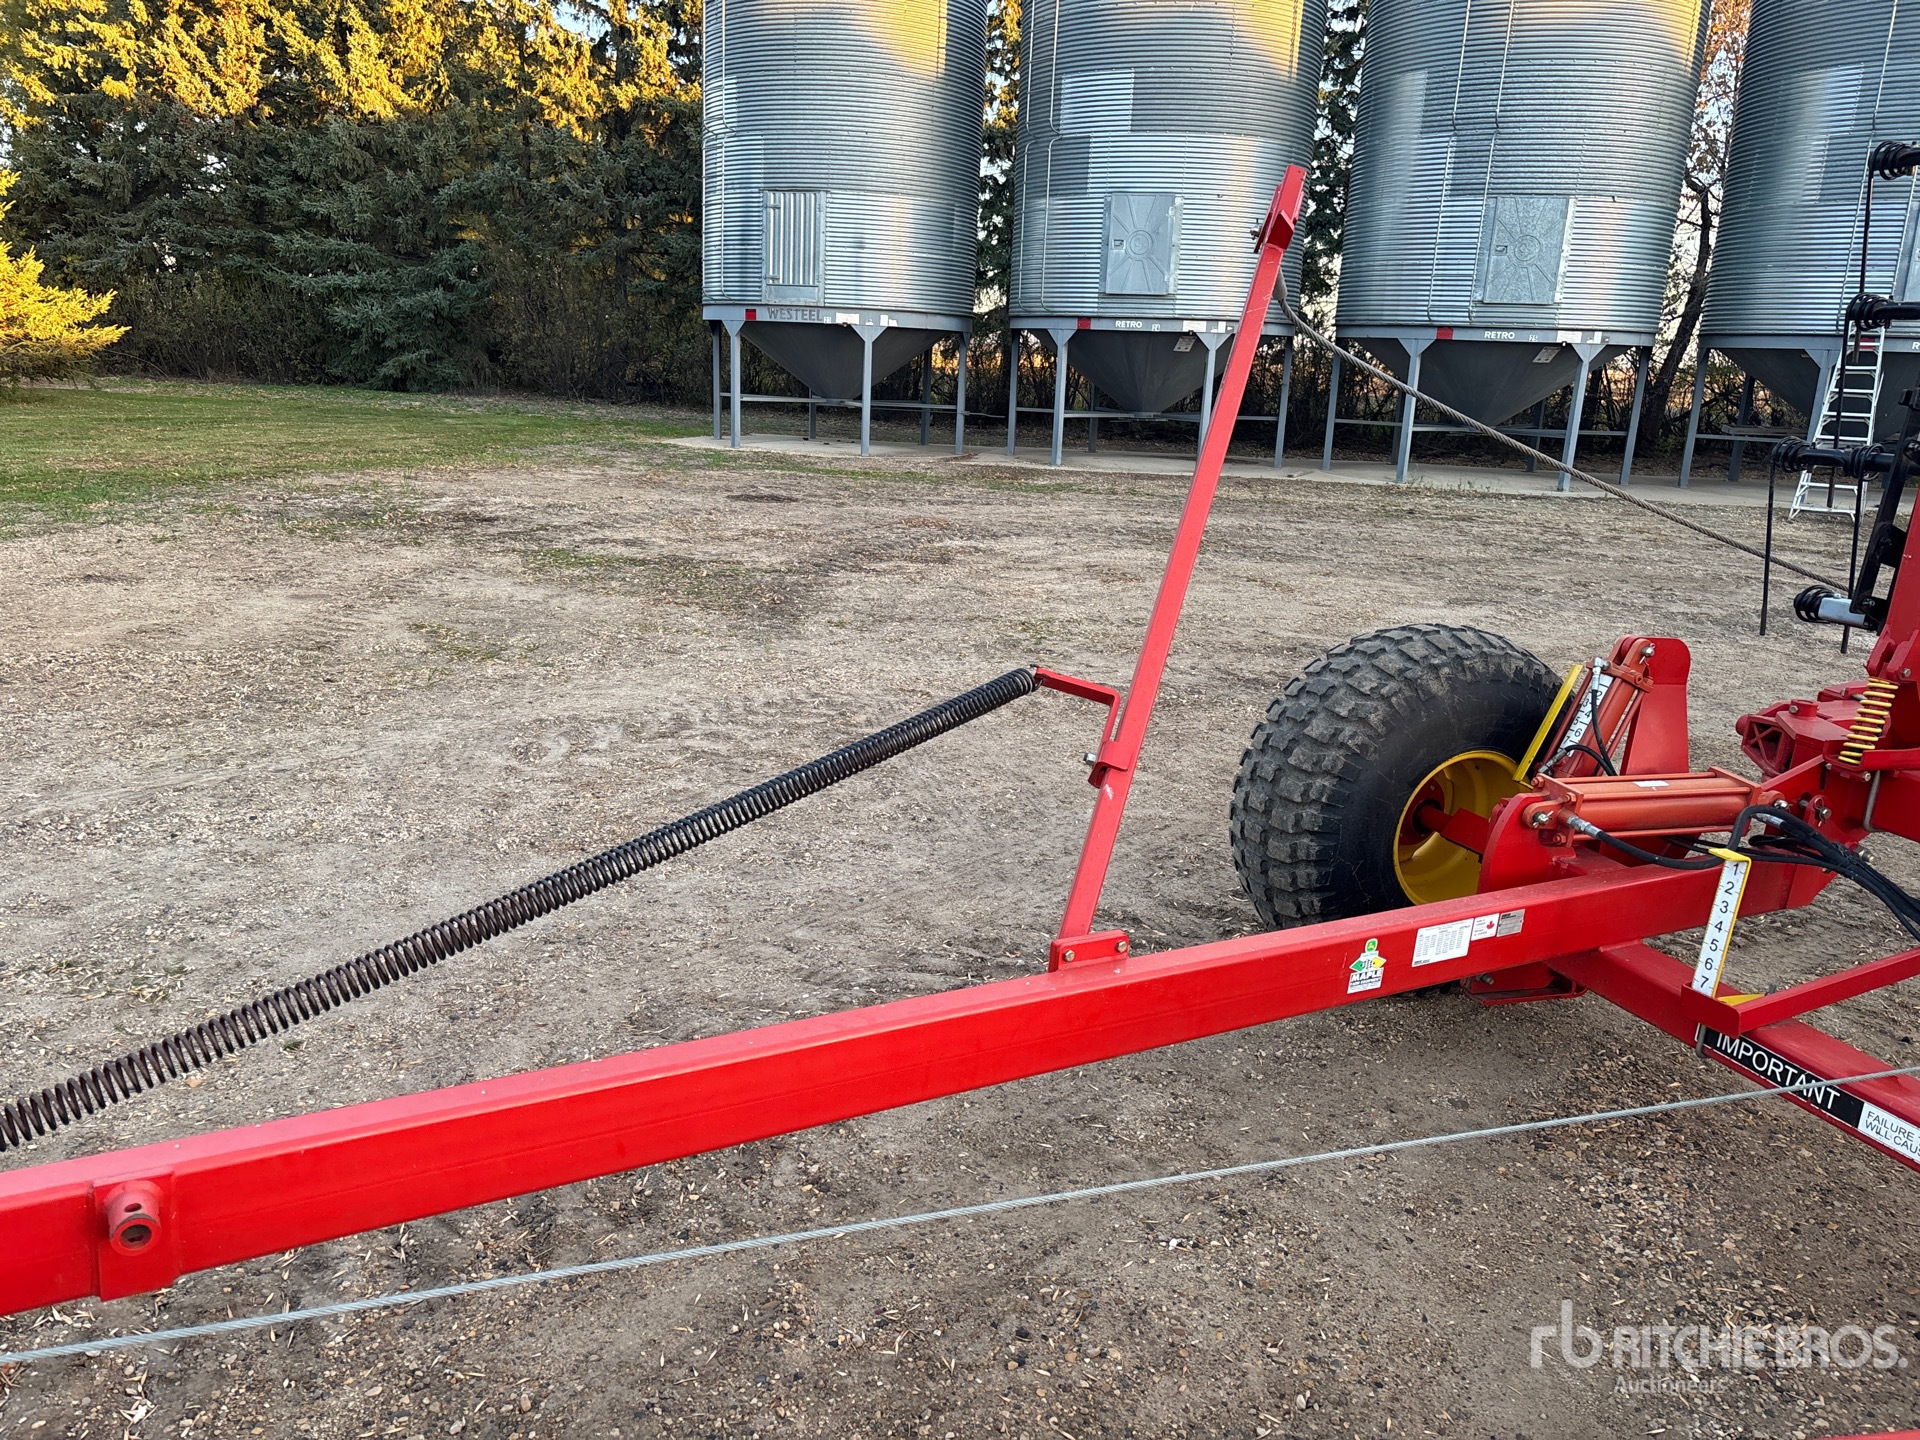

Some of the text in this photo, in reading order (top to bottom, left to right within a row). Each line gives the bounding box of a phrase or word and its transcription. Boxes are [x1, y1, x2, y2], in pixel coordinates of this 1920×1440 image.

[767, 307, 822, 321] WESTEEL
[1115, 321, 1143, 329] RETRO
[1484, 331, 1515, 339] RETRO
[1583, 699, 1589, 707] 3
[1584, 710, 1592, 718] 4
[1574, 717, 1580, 725] 5
[1574, 728, 1582, 737] 6
[1563, 736, 1571, 744] 7
[1733, 863, 1739, 876] 1
[1724, 881, 1734, 895] 2
[1719, 900, 1729, 914] 3
[1714, 920, 1723, 933] 4
[1709, 939, 1718, 951] 5
[1704, 958, 1713, 971] 6
[1351, 969, 1382, 981] MAPLE
[1700, 976, 1709, 988] 7
[1716, 1032, 1841, 1110] IMPORTANT
[1865, 1119, 1890, 1141] WILL
[1867, 1111, 1915, 1143] FAILURE
